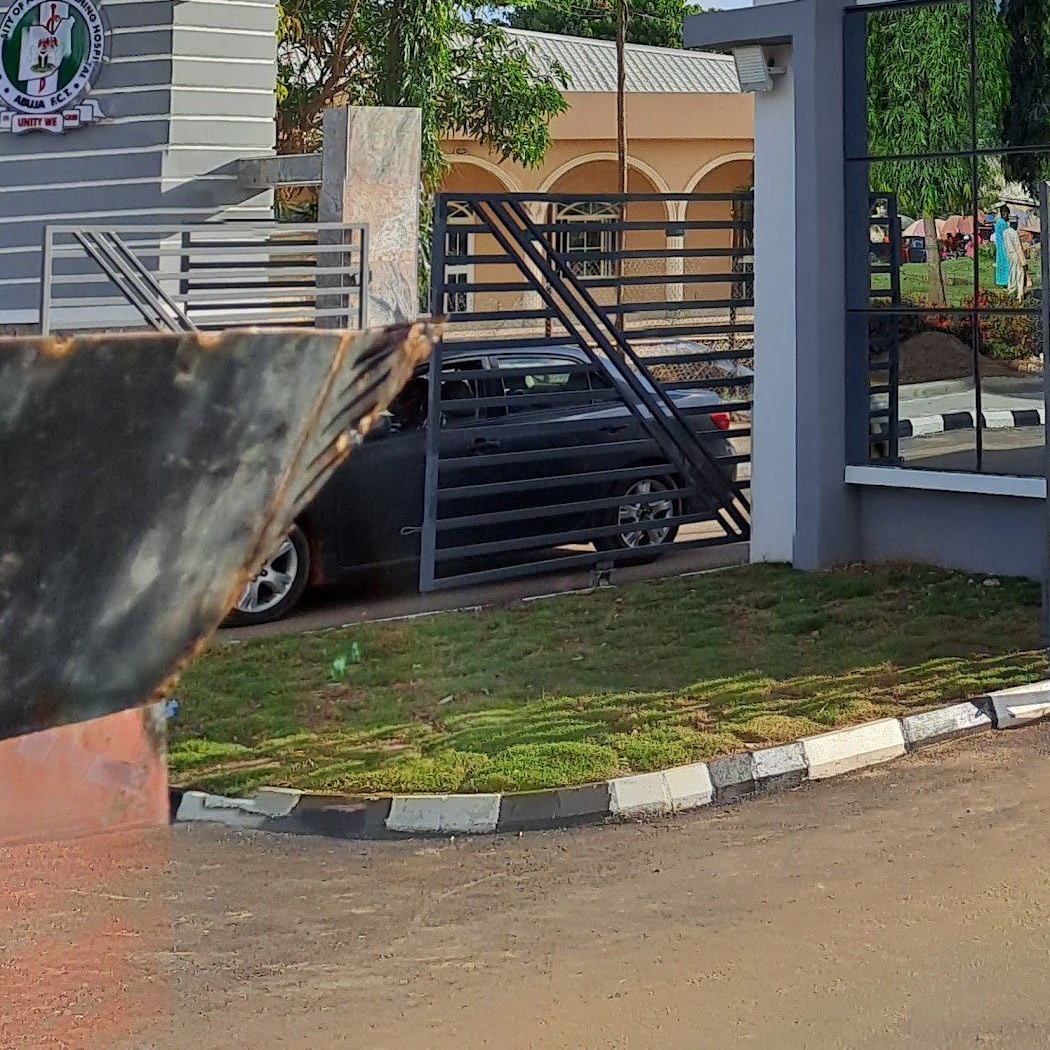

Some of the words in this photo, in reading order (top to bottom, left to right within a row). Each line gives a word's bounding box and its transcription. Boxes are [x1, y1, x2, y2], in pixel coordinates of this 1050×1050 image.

[12, 1, 24, 16] OF
[78, 24, 102, 79] HOSPITAL
[13, 95, 46, 109] ABUJA
[17, 117, 43, 127] UNITY
[44, 116, 58, 127] WE
